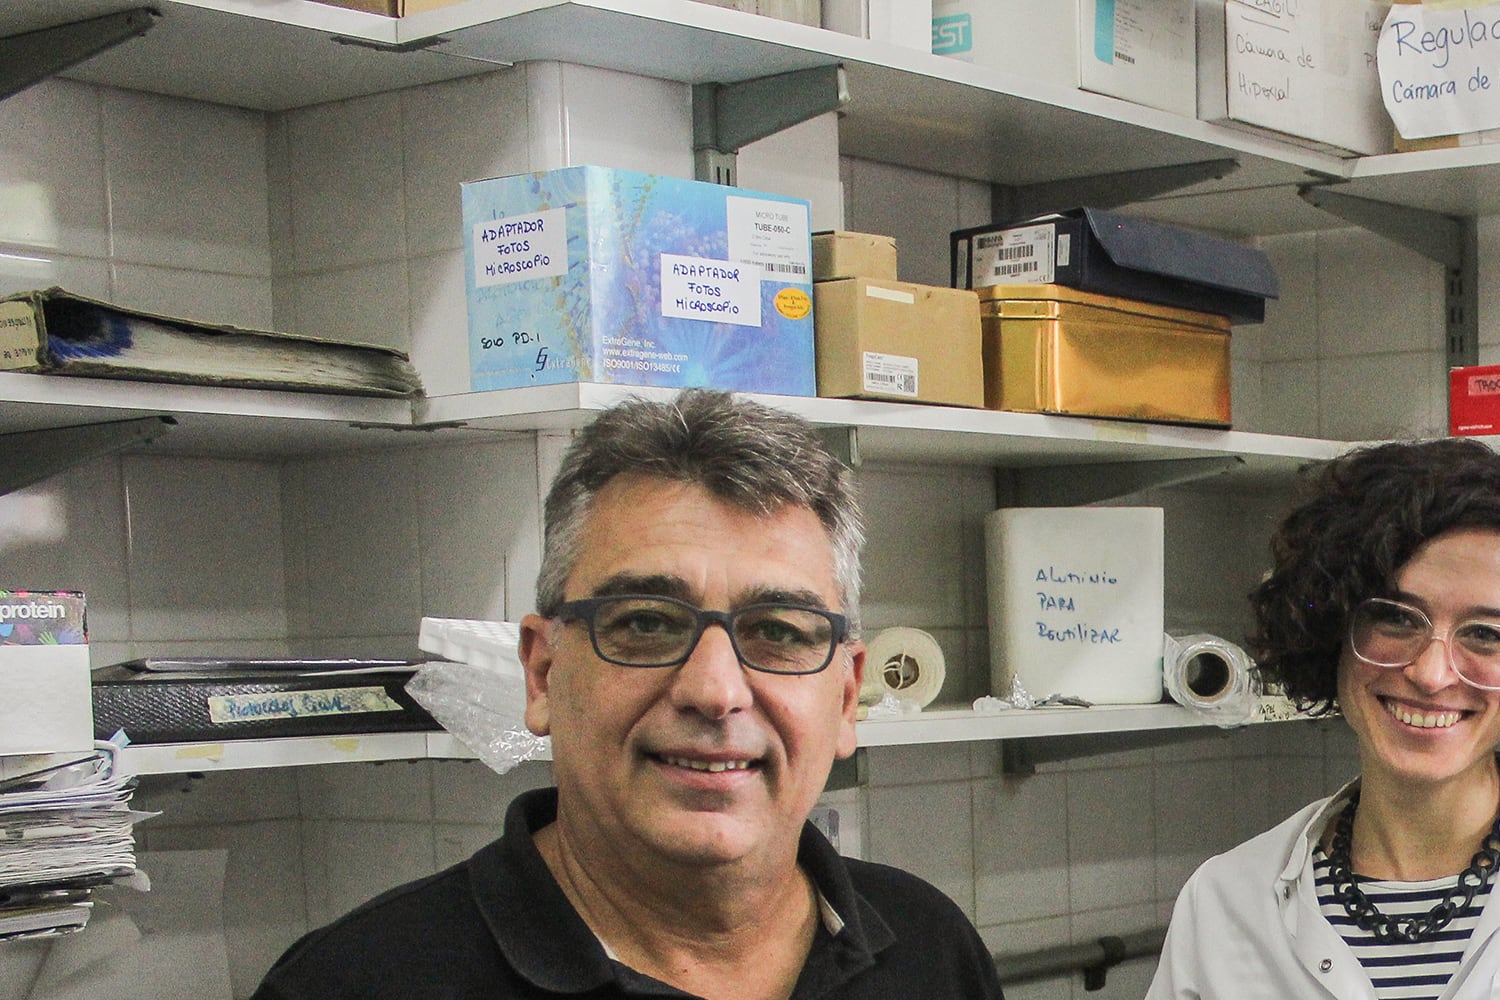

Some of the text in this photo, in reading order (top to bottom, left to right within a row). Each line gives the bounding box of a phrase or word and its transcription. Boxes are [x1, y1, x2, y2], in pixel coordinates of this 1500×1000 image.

[1392, 80, 1457, 104] Cámara
[1467, 66, 1491, 92] de
[481, 219, 544, 243] ADAPTADOR
[497, 240, 530, 255] FOTOS
[485, 254, 550, 276] MICROSCOPIO
[673, 264, 740, 282] ADAPTADOR
[687, 282, 721, 296] FOTOS
[675, 297, 740, 314] MICROSCOPIO
[0, 600, 66, 623] protein
[1036, 592, 1076, 612] PARA
